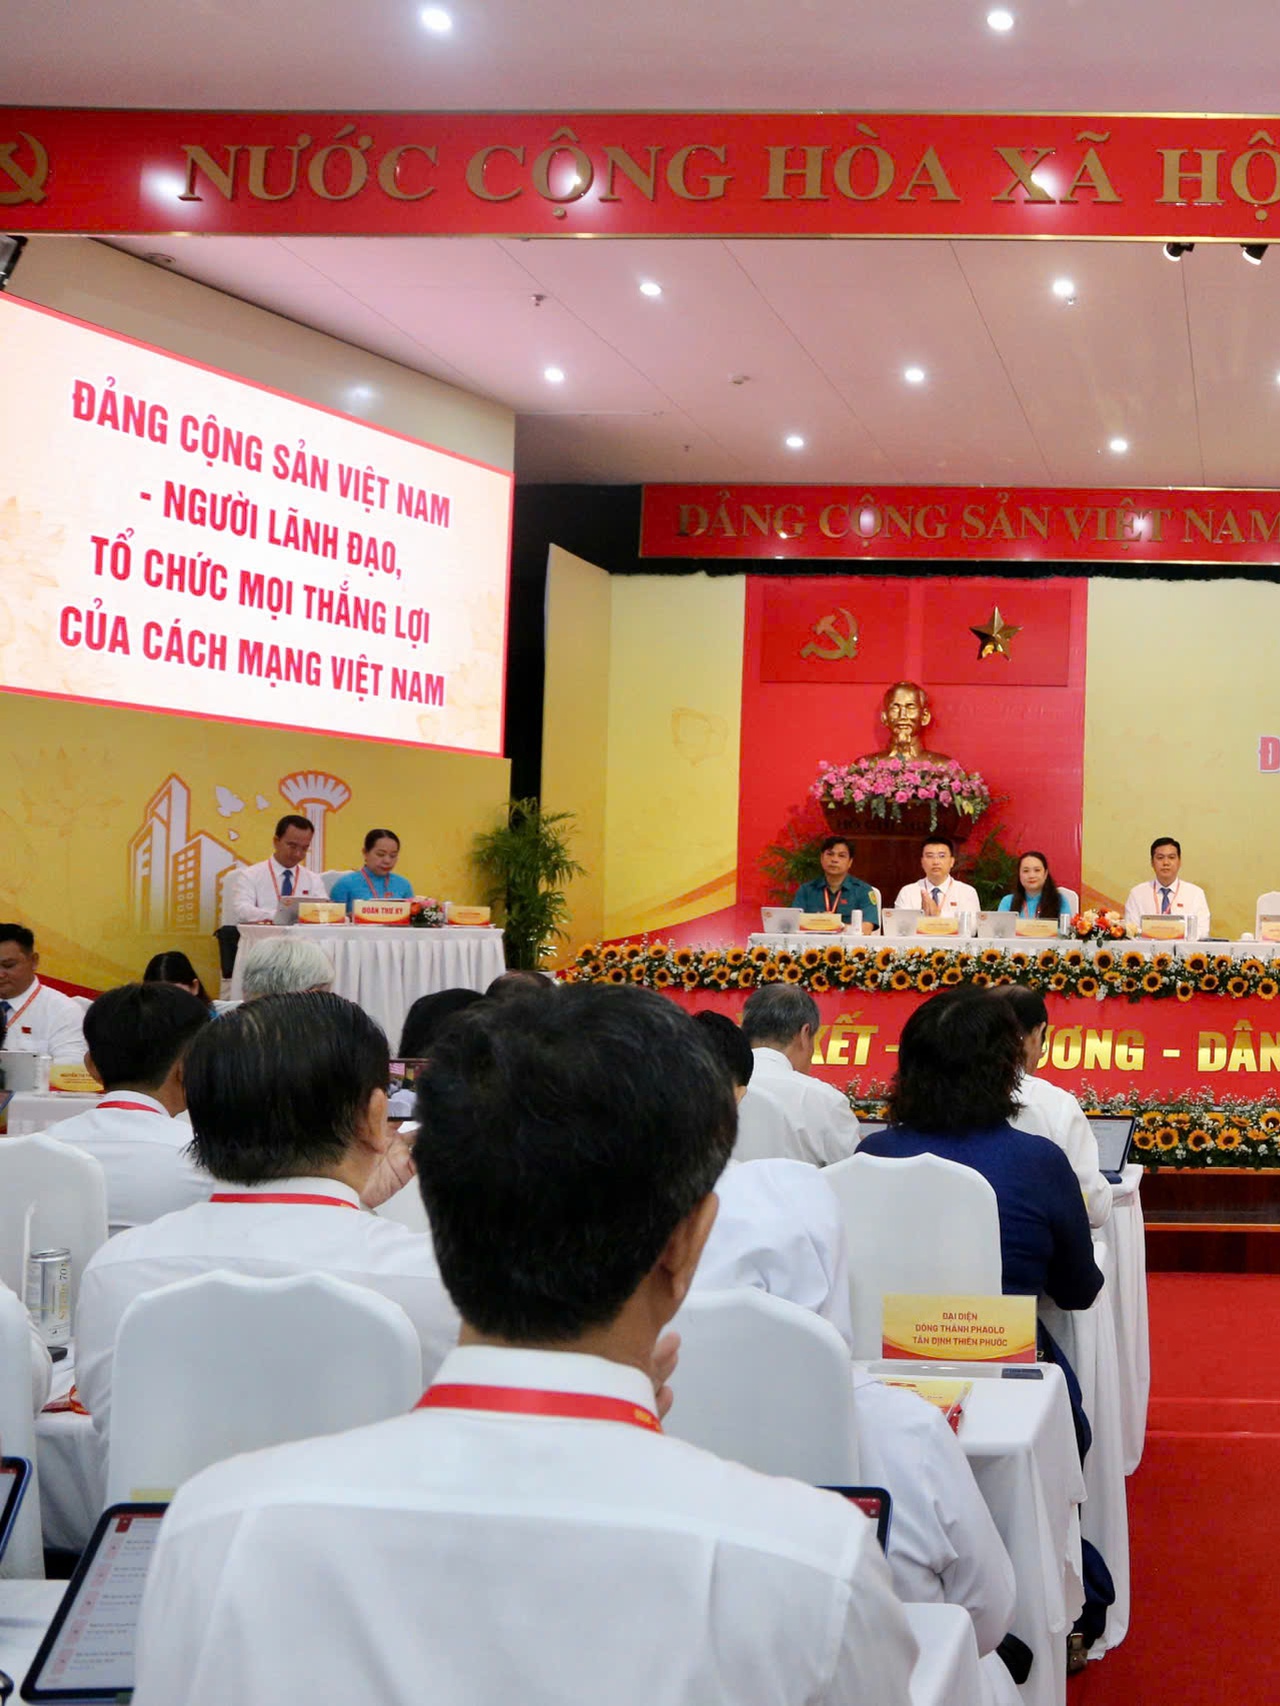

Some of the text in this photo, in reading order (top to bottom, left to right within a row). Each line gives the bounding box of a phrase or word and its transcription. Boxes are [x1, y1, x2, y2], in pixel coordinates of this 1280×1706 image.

[177, 124, 438, 202] NƯỚC
[465, 129, 736, 219] CỘNG
[760, 123, 961, 202] HÒA
[991, 129, 1123, 204] XÃ
[72, 376, 450, 528] ĐẢNG CỘNG SẢN VIỆT NAM
[163, 480, 258, 539] NGƯỜI
[268, 507, 338, 560] LÃNH
[347, 531, 401, 579] ĐẠO,
[818, 492, 949, 549] CỘNG
[960, 491, 1050, 542] SẢN
[1062, 498, 1174, 551] VIỆT
[90, 528, 430, 649] TỔ CHỨC MỌI THẮNG LỢI
[60, 598, 444, 706] CỦA CÁCH MẠNG VIỆT NAM
